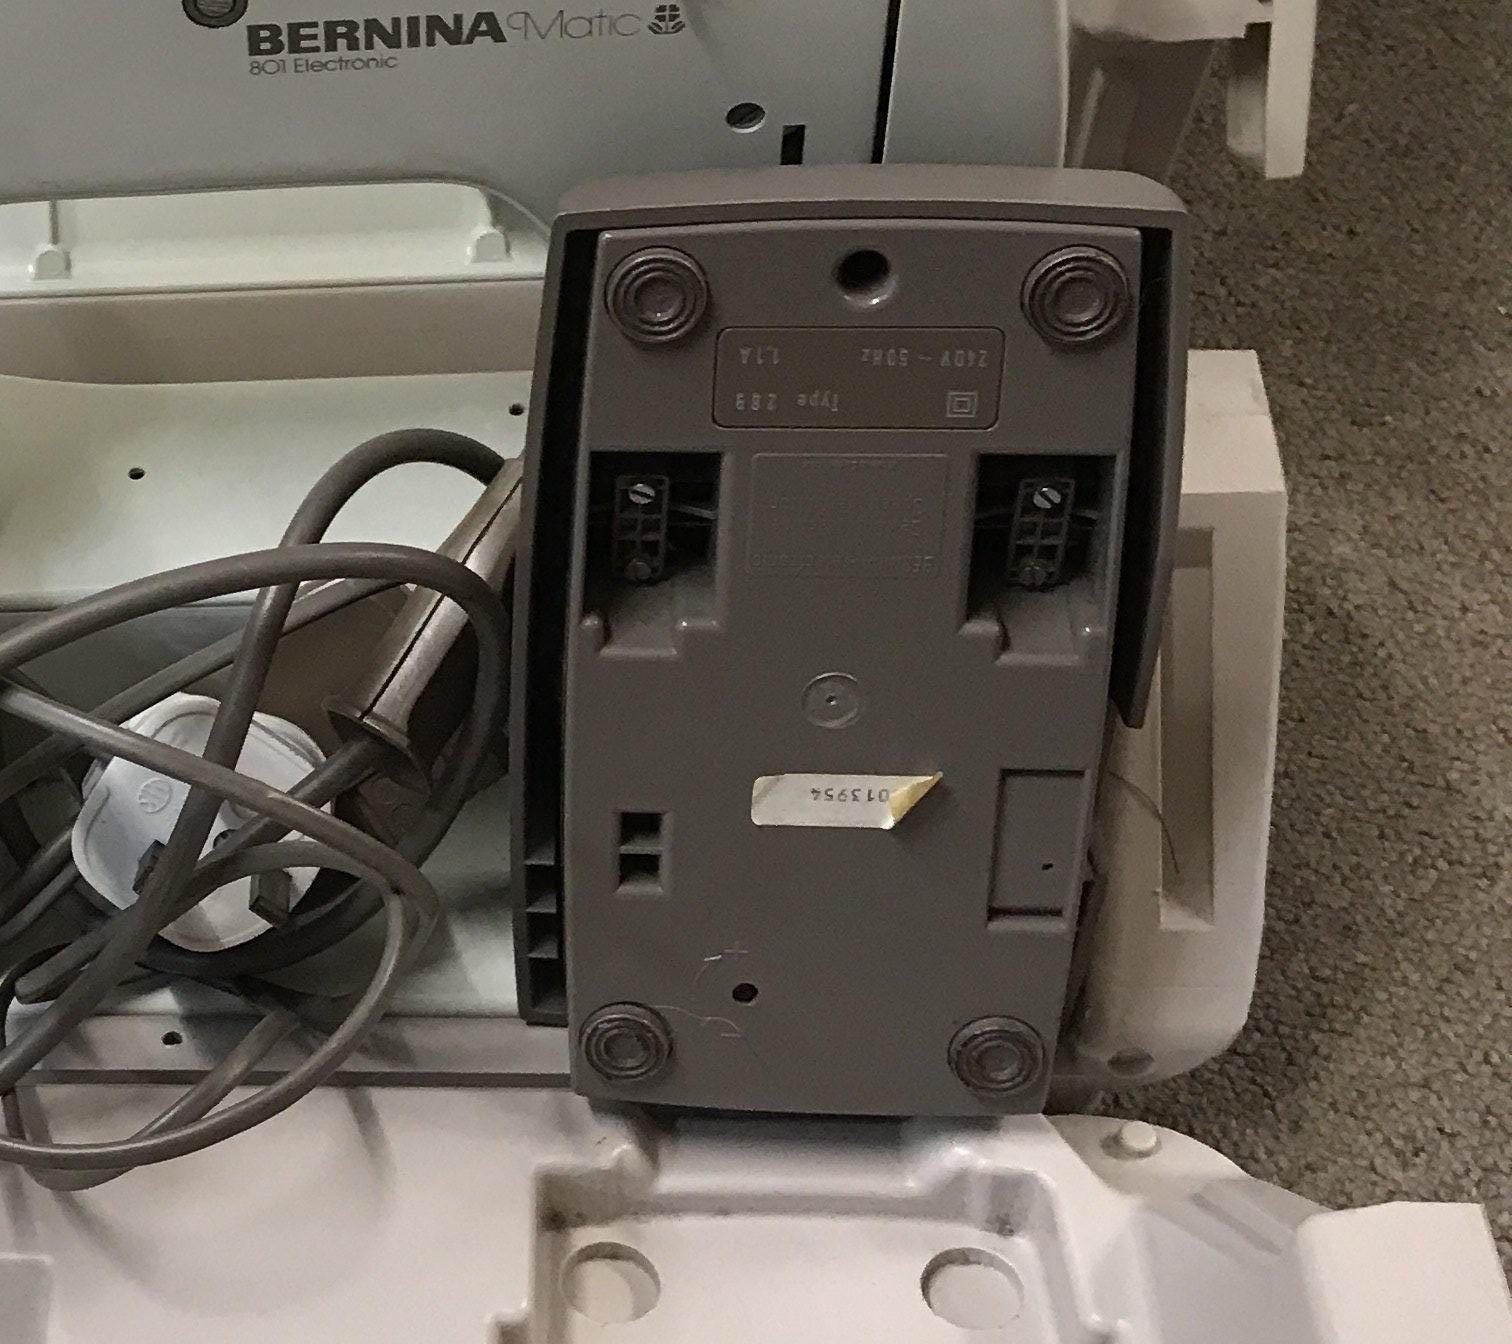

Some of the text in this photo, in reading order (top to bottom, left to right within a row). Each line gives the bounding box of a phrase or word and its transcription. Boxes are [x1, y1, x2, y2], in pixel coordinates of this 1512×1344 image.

[246, 8, 641, 56] BERNINA Matic
[248, 54, 399, 76] 801 Electronic
[797, 389, 839, 412] Type
